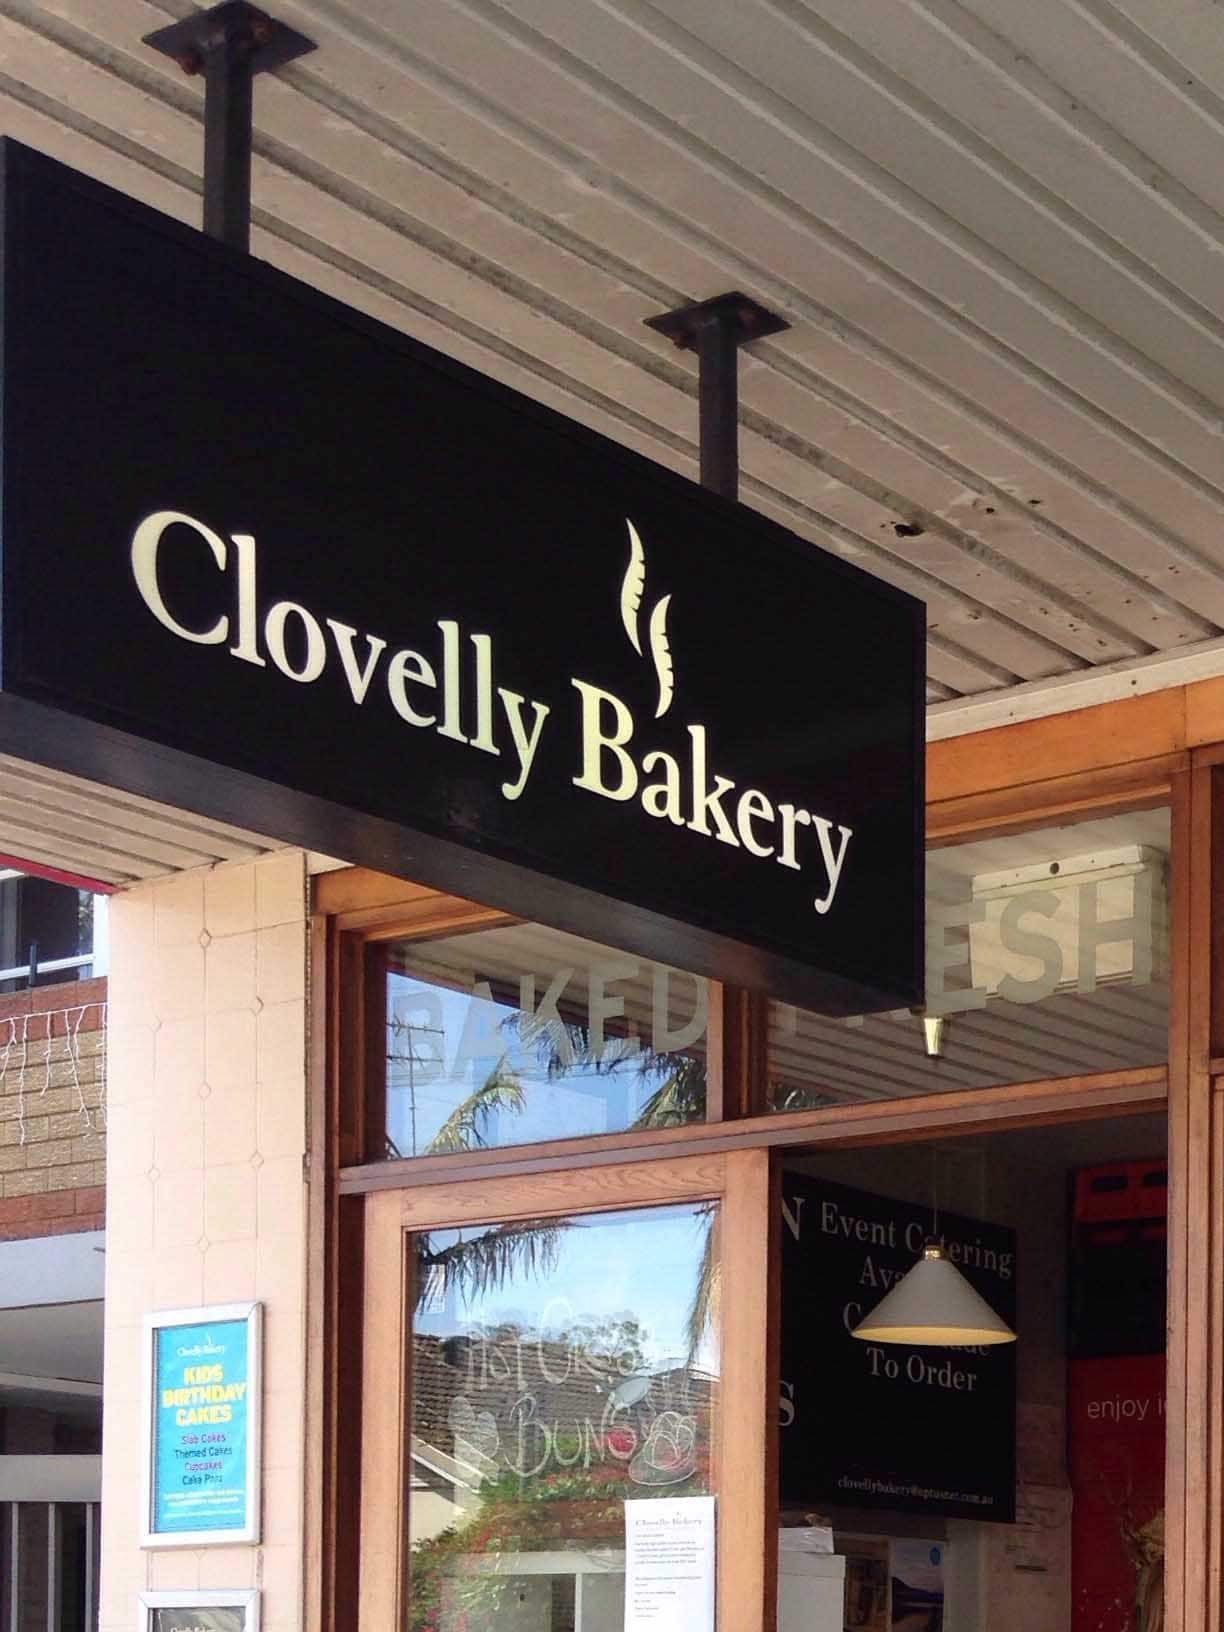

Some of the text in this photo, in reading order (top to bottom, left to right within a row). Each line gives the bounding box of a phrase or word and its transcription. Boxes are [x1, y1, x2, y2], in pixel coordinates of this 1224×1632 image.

[129, 509, 852, 916] Clovelly Bakery
[392, 962, 710, 1080] BAKED
[821, 1201, 896, 1249] Event
[185, 1365, 224, 1384] KIDS
[867, 1347, 977, 1391] To Order
[164, 1383, 246, 1407] BIRTHDAY
[177, 1405, 232, 1426] CAKES
[1087, 1393, 1149, 1423] enjoy
[201, 1432, 226, 1444] Cakes
[174, 1448, 207, 1460] Themed
[184, 1461, 223, 1474] Cupcakes
